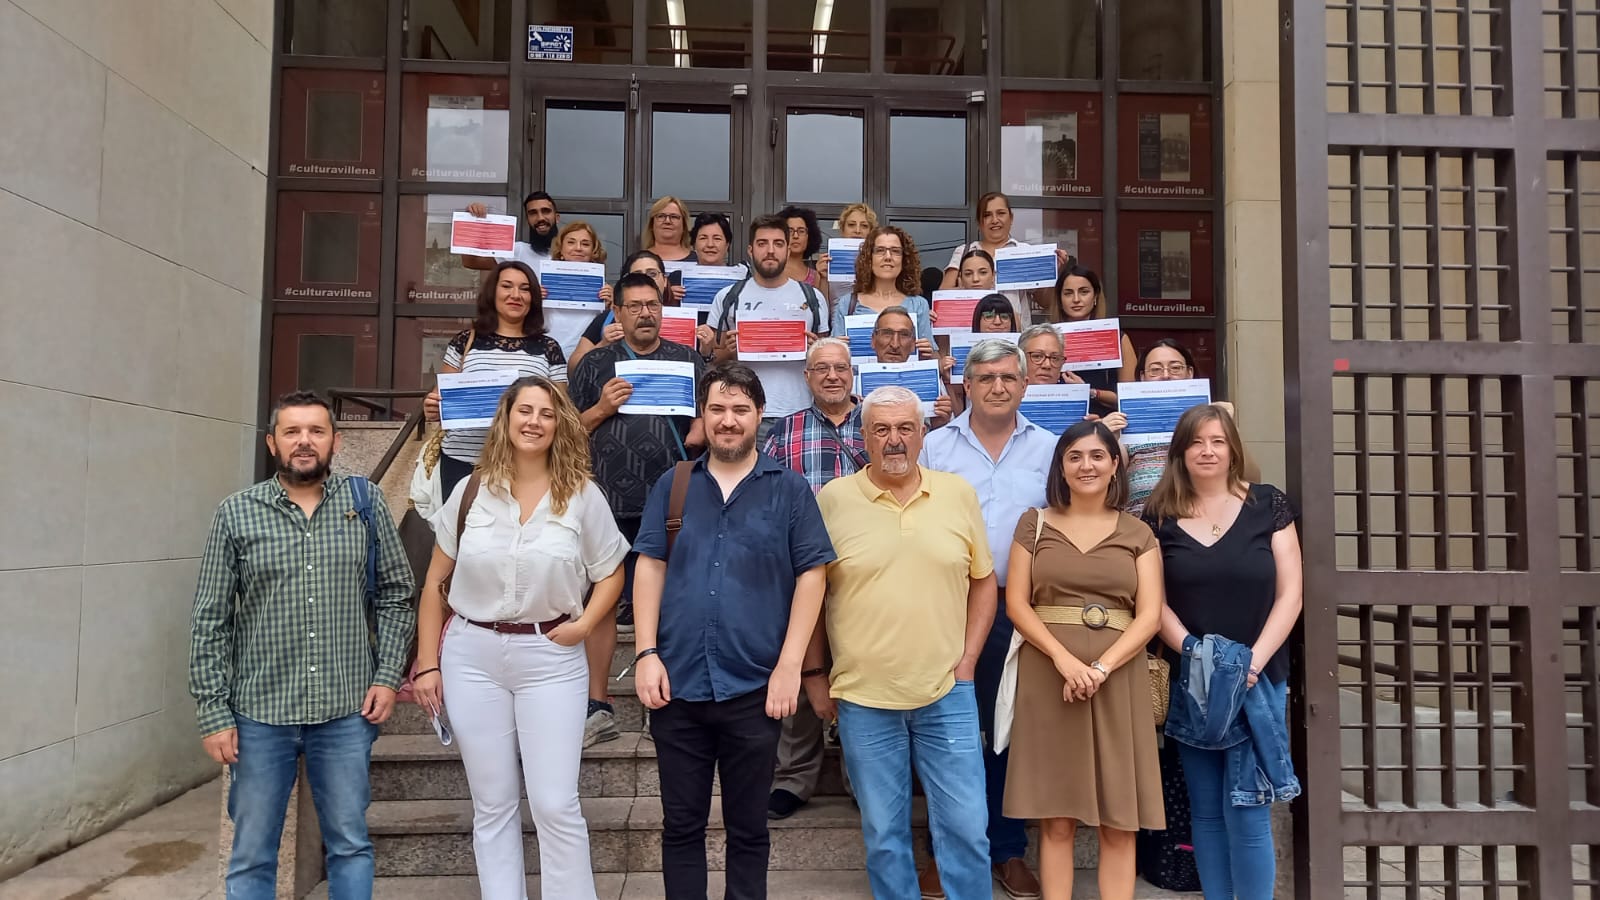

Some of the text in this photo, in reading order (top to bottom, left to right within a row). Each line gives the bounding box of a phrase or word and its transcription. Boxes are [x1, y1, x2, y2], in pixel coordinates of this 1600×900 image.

[289, 164, 376, 175] #culturavillena
[411, 168, 497, 179] #culturavillena
[1011, 183, 1092, 194] #culturavillena
[1124, 185, 1205, 196] #culturavillena
[284, 287, 372, 298] #culturavillena
[1125, 302, 1206, 313] #culturavillena
